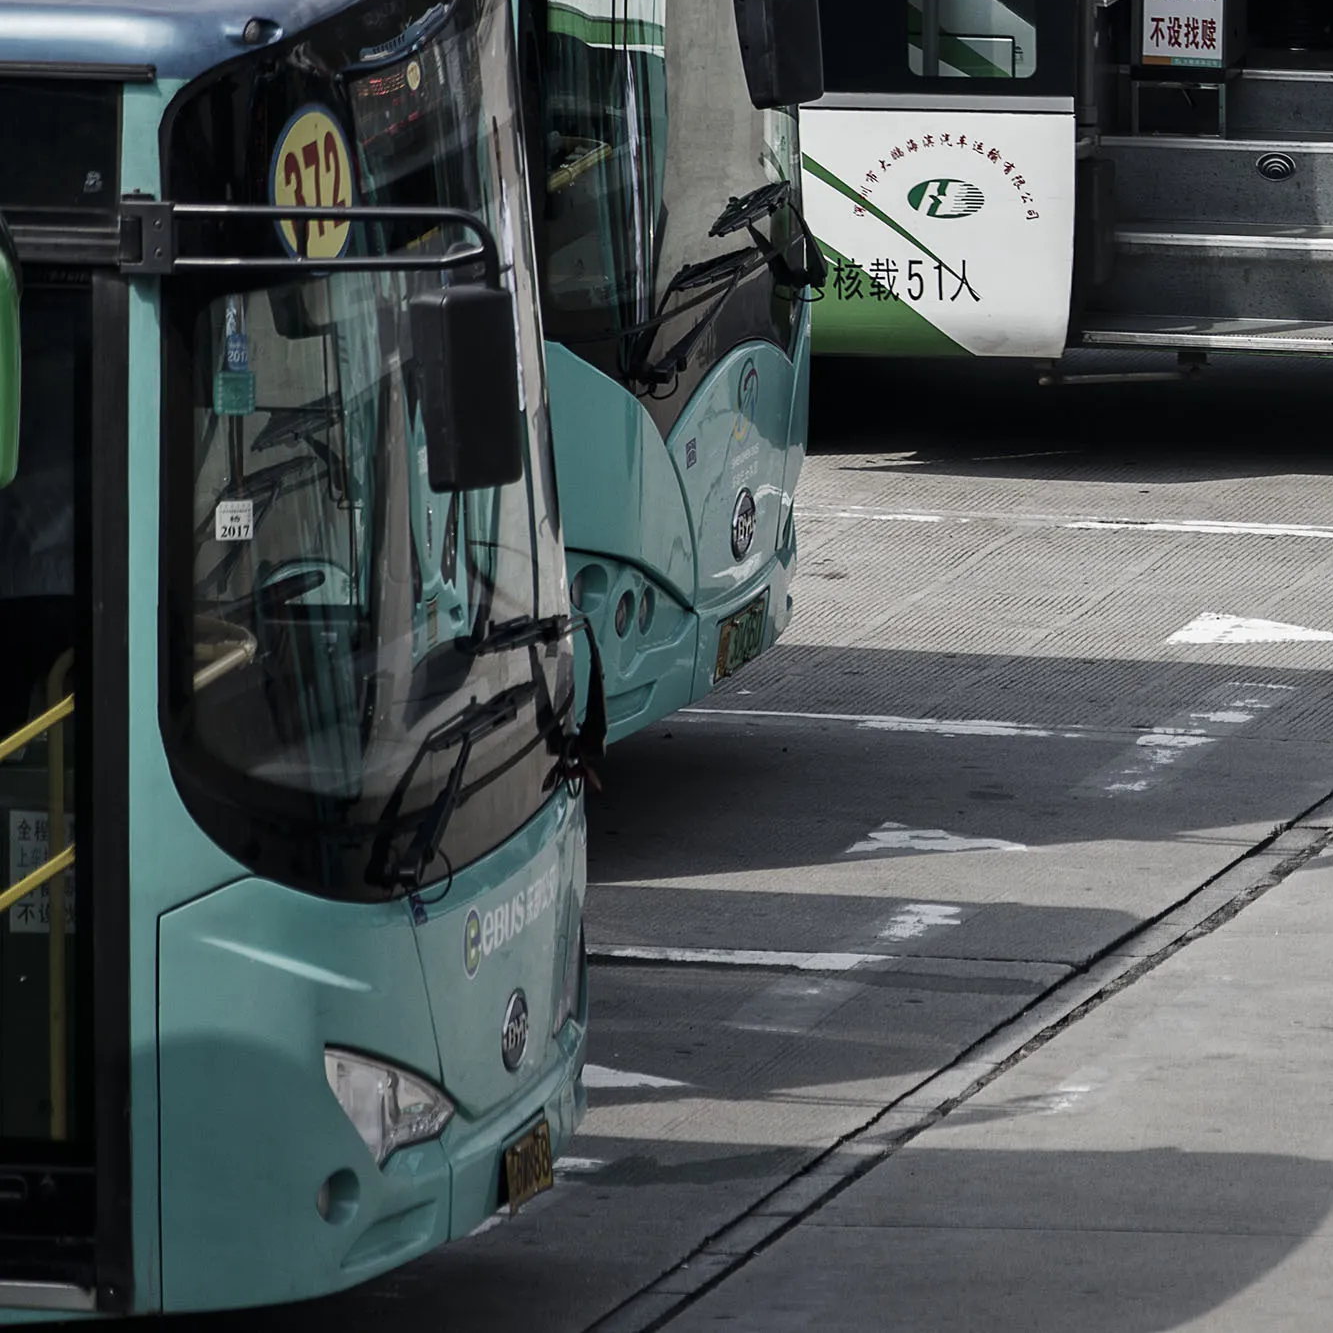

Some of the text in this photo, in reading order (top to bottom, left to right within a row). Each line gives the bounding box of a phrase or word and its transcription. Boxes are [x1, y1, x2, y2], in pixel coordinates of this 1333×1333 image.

[1149, 16, 1217, 50] 不设找赎
[285, 130, 346, 239] 372
[833, 257, 981, 303] 核载51人
[220, 524, 251, 539] 2017
